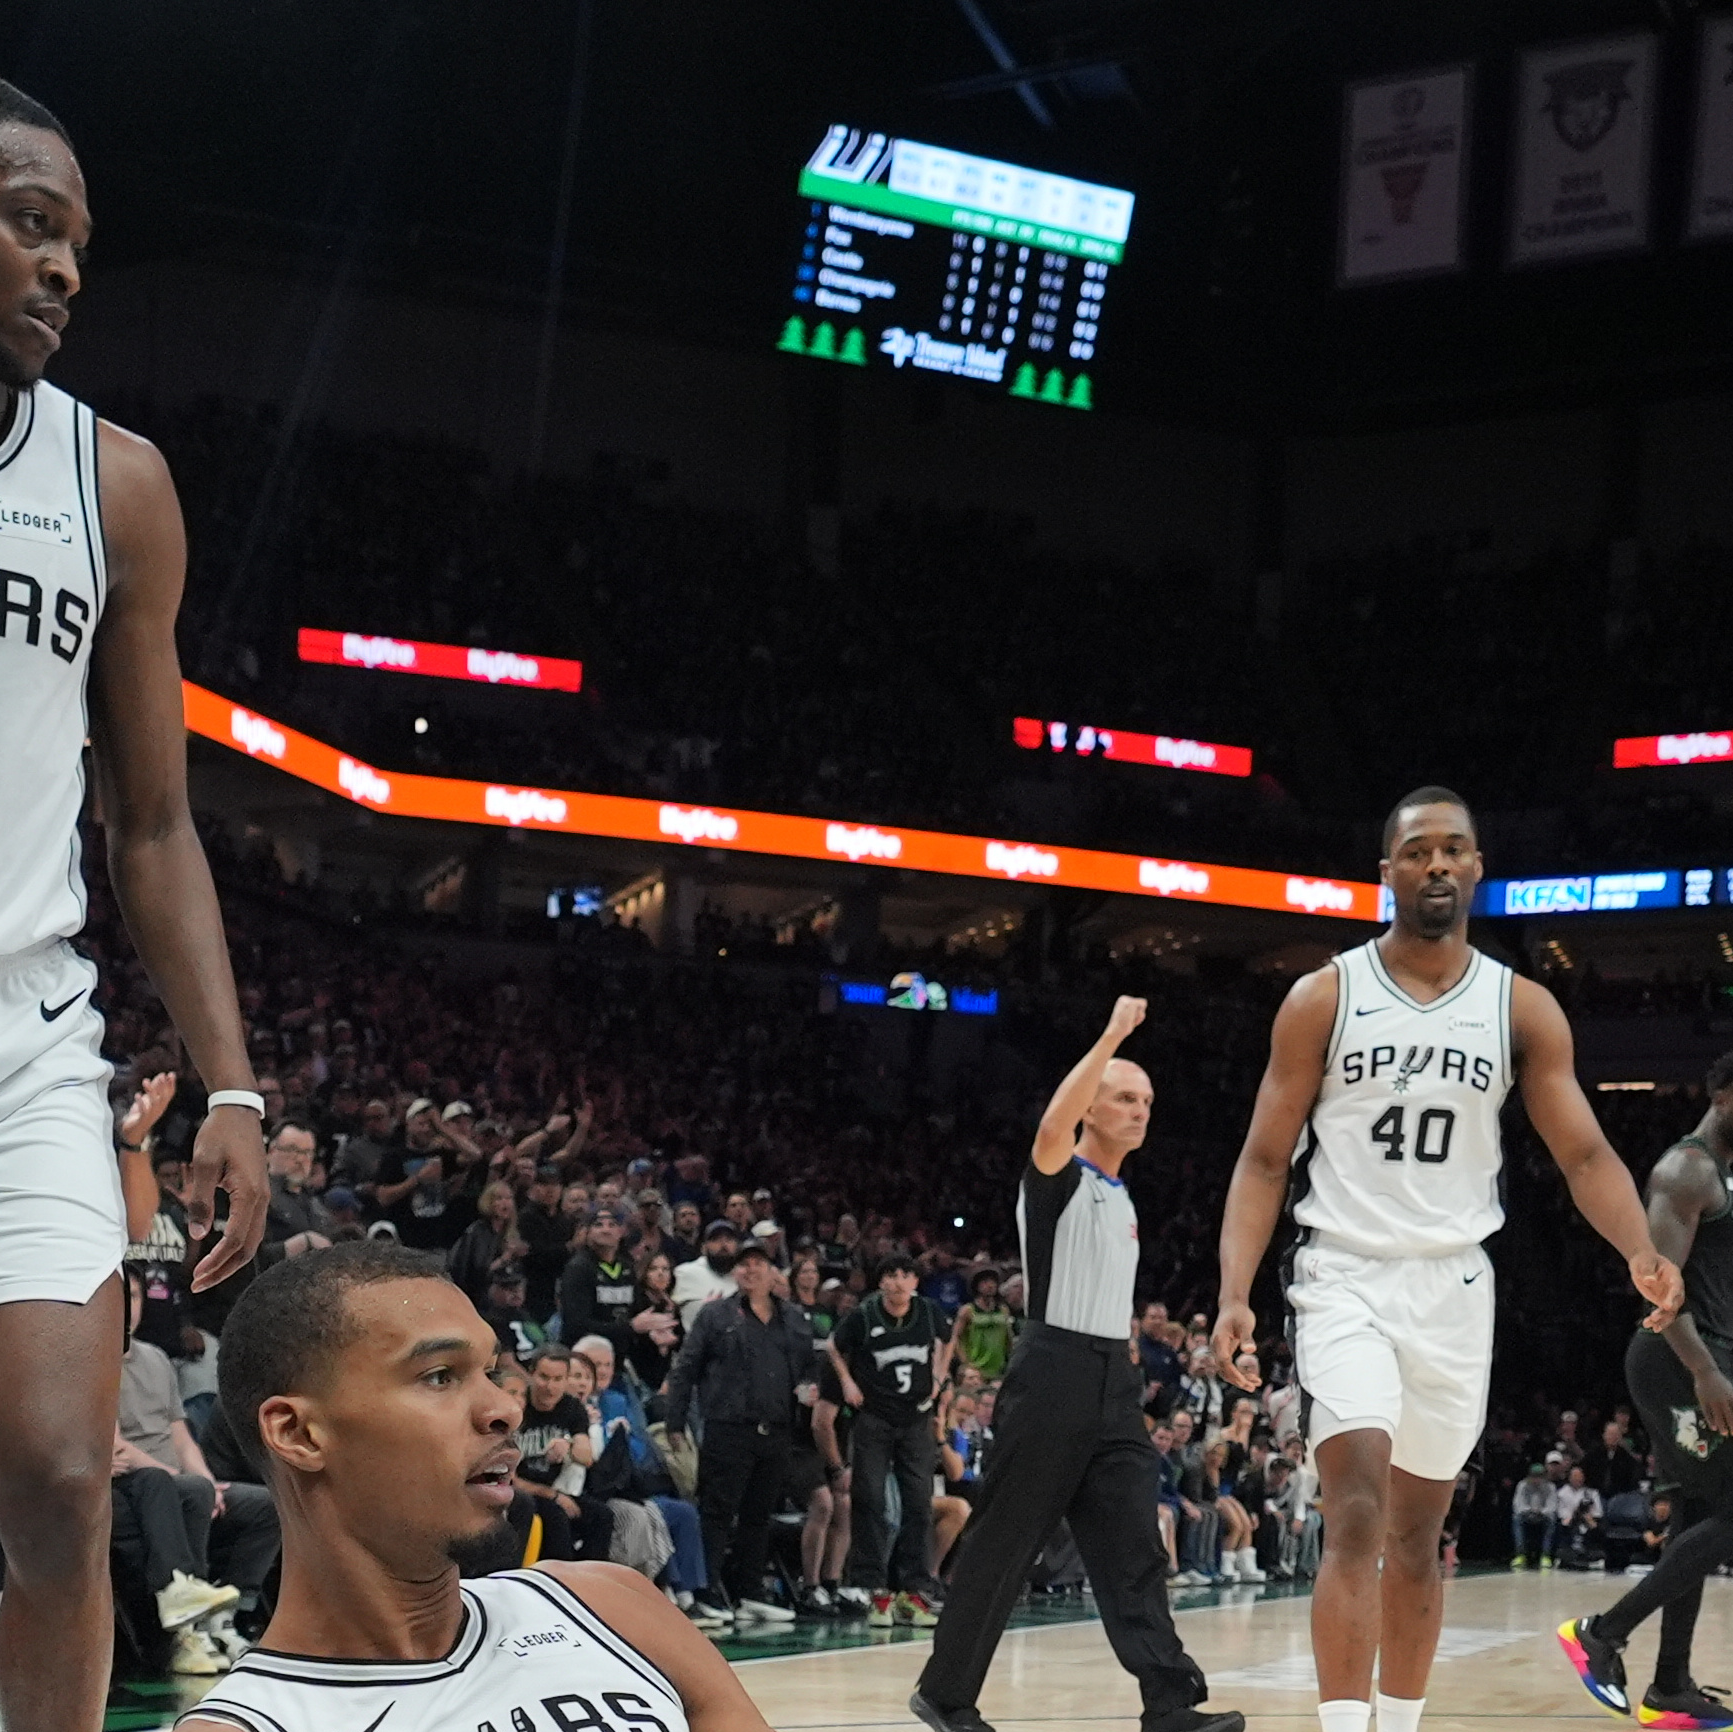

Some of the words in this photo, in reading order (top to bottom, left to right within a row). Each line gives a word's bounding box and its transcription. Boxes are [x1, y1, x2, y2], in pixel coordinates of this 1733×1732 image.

[0, 508, 63, 533] LEDGER
[1342, 1045, 1494, 1094] SPURS
[1371, 1106, 1455, 1163] 40
[894, 1363, 914, 1395] 5
[512, 1628, 567, 1650] LEDGER
